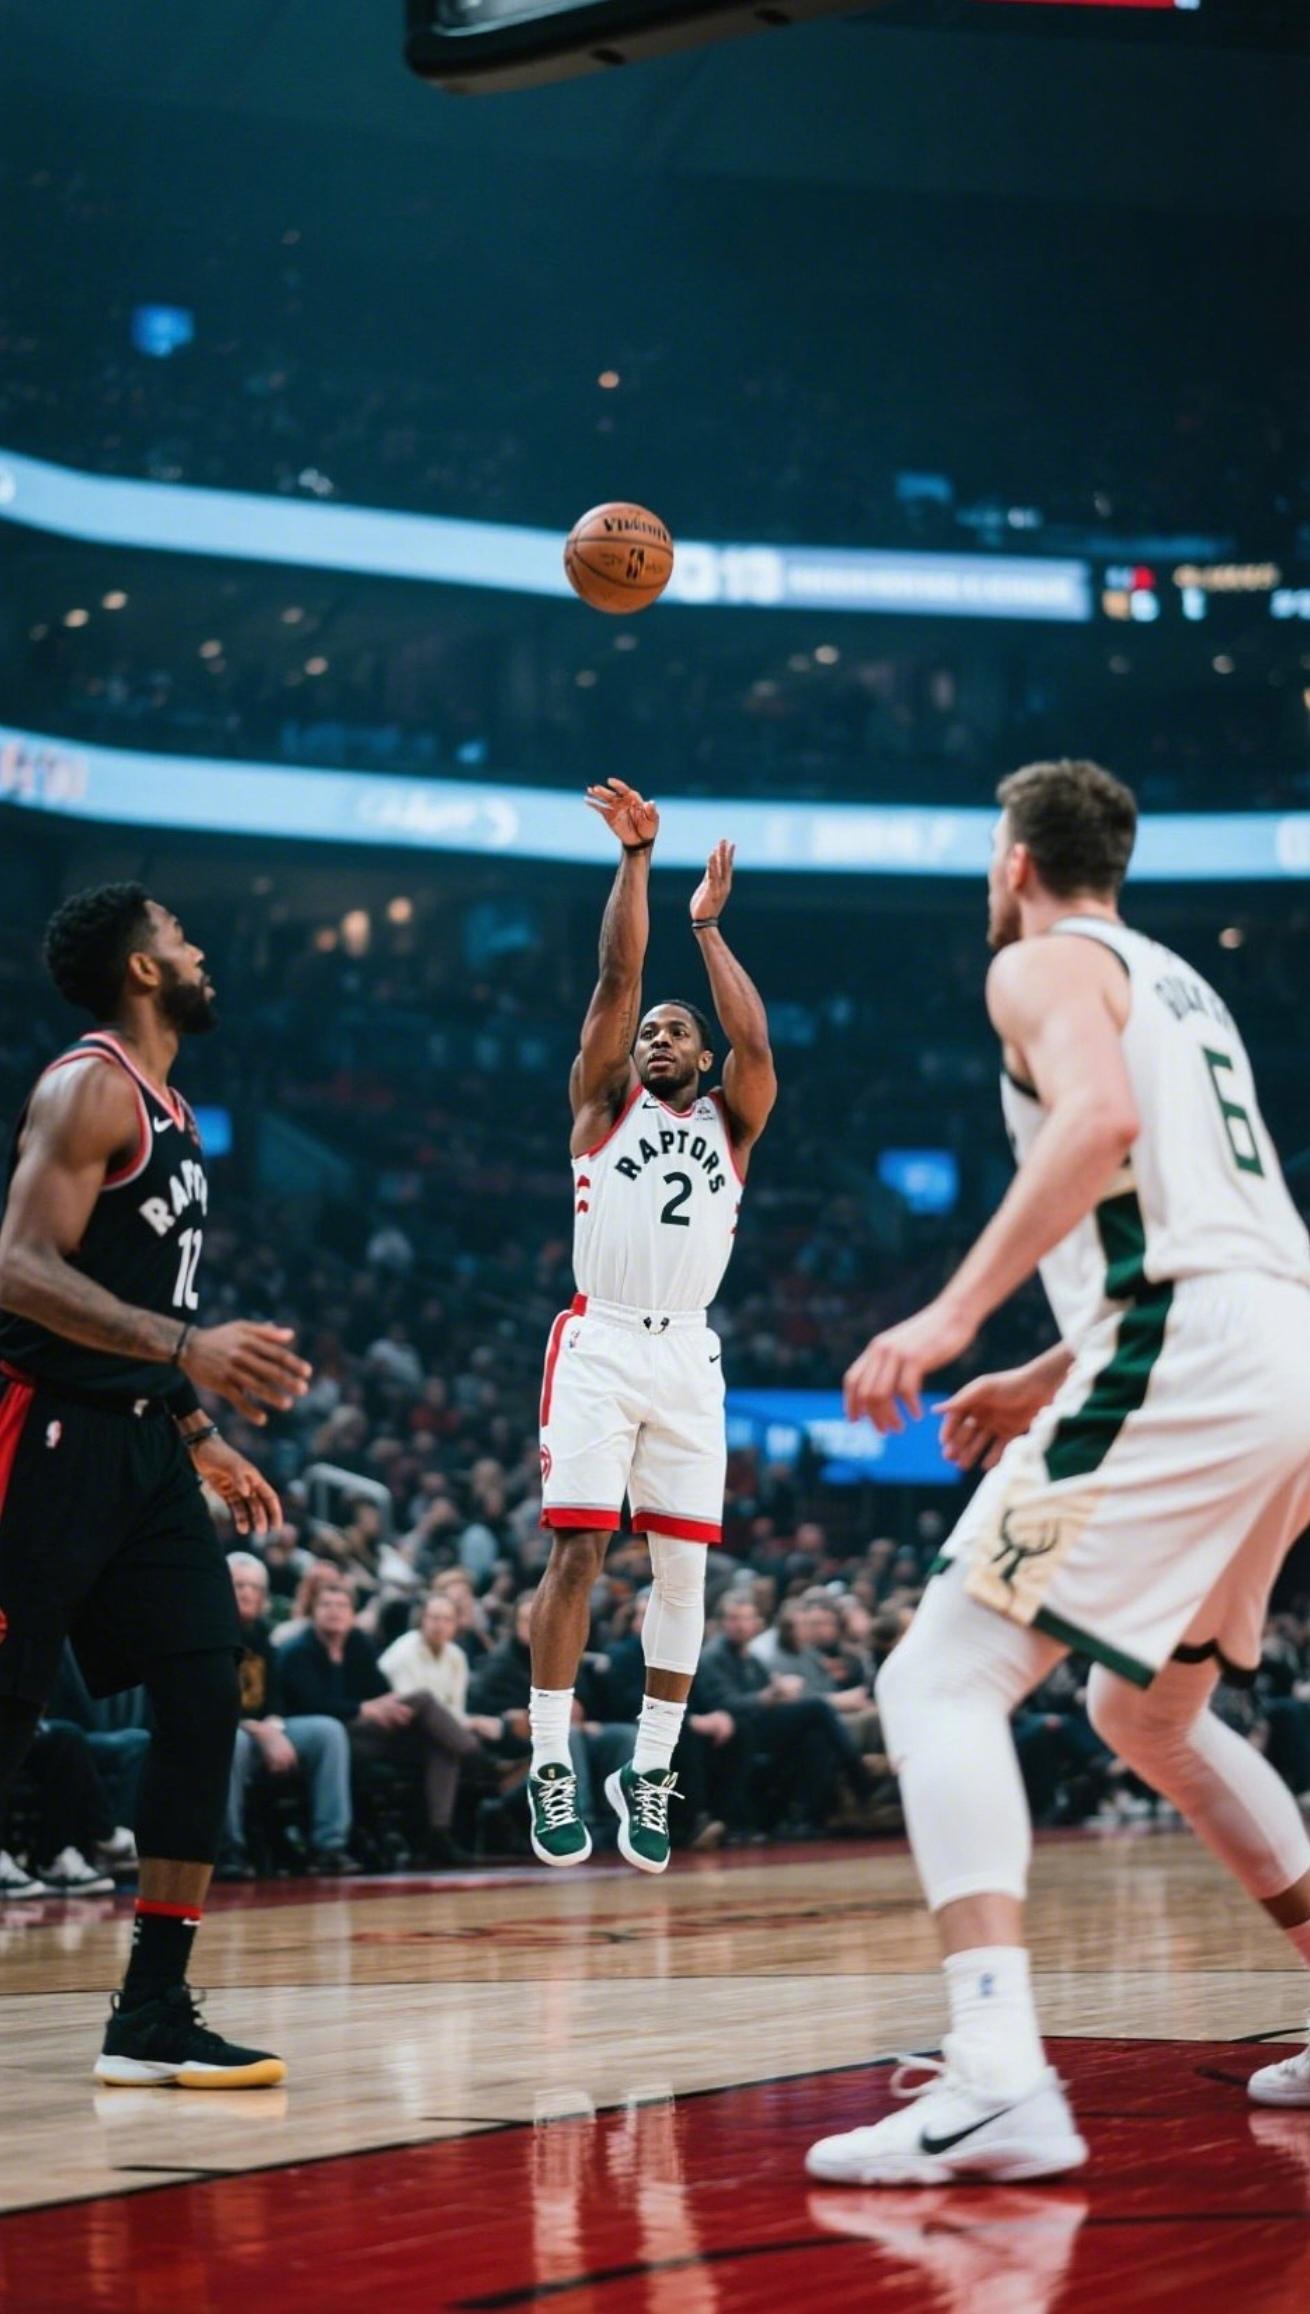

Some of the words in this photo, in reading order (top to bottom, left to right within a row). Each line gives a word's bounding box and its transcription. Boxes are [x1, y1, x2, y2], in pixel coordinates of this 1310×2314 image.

[1202, 1045, 1265, 1178] 6
[614, 1129, 726, 1194] RAPTORS
[660, 1171, 693, 1227] 2
